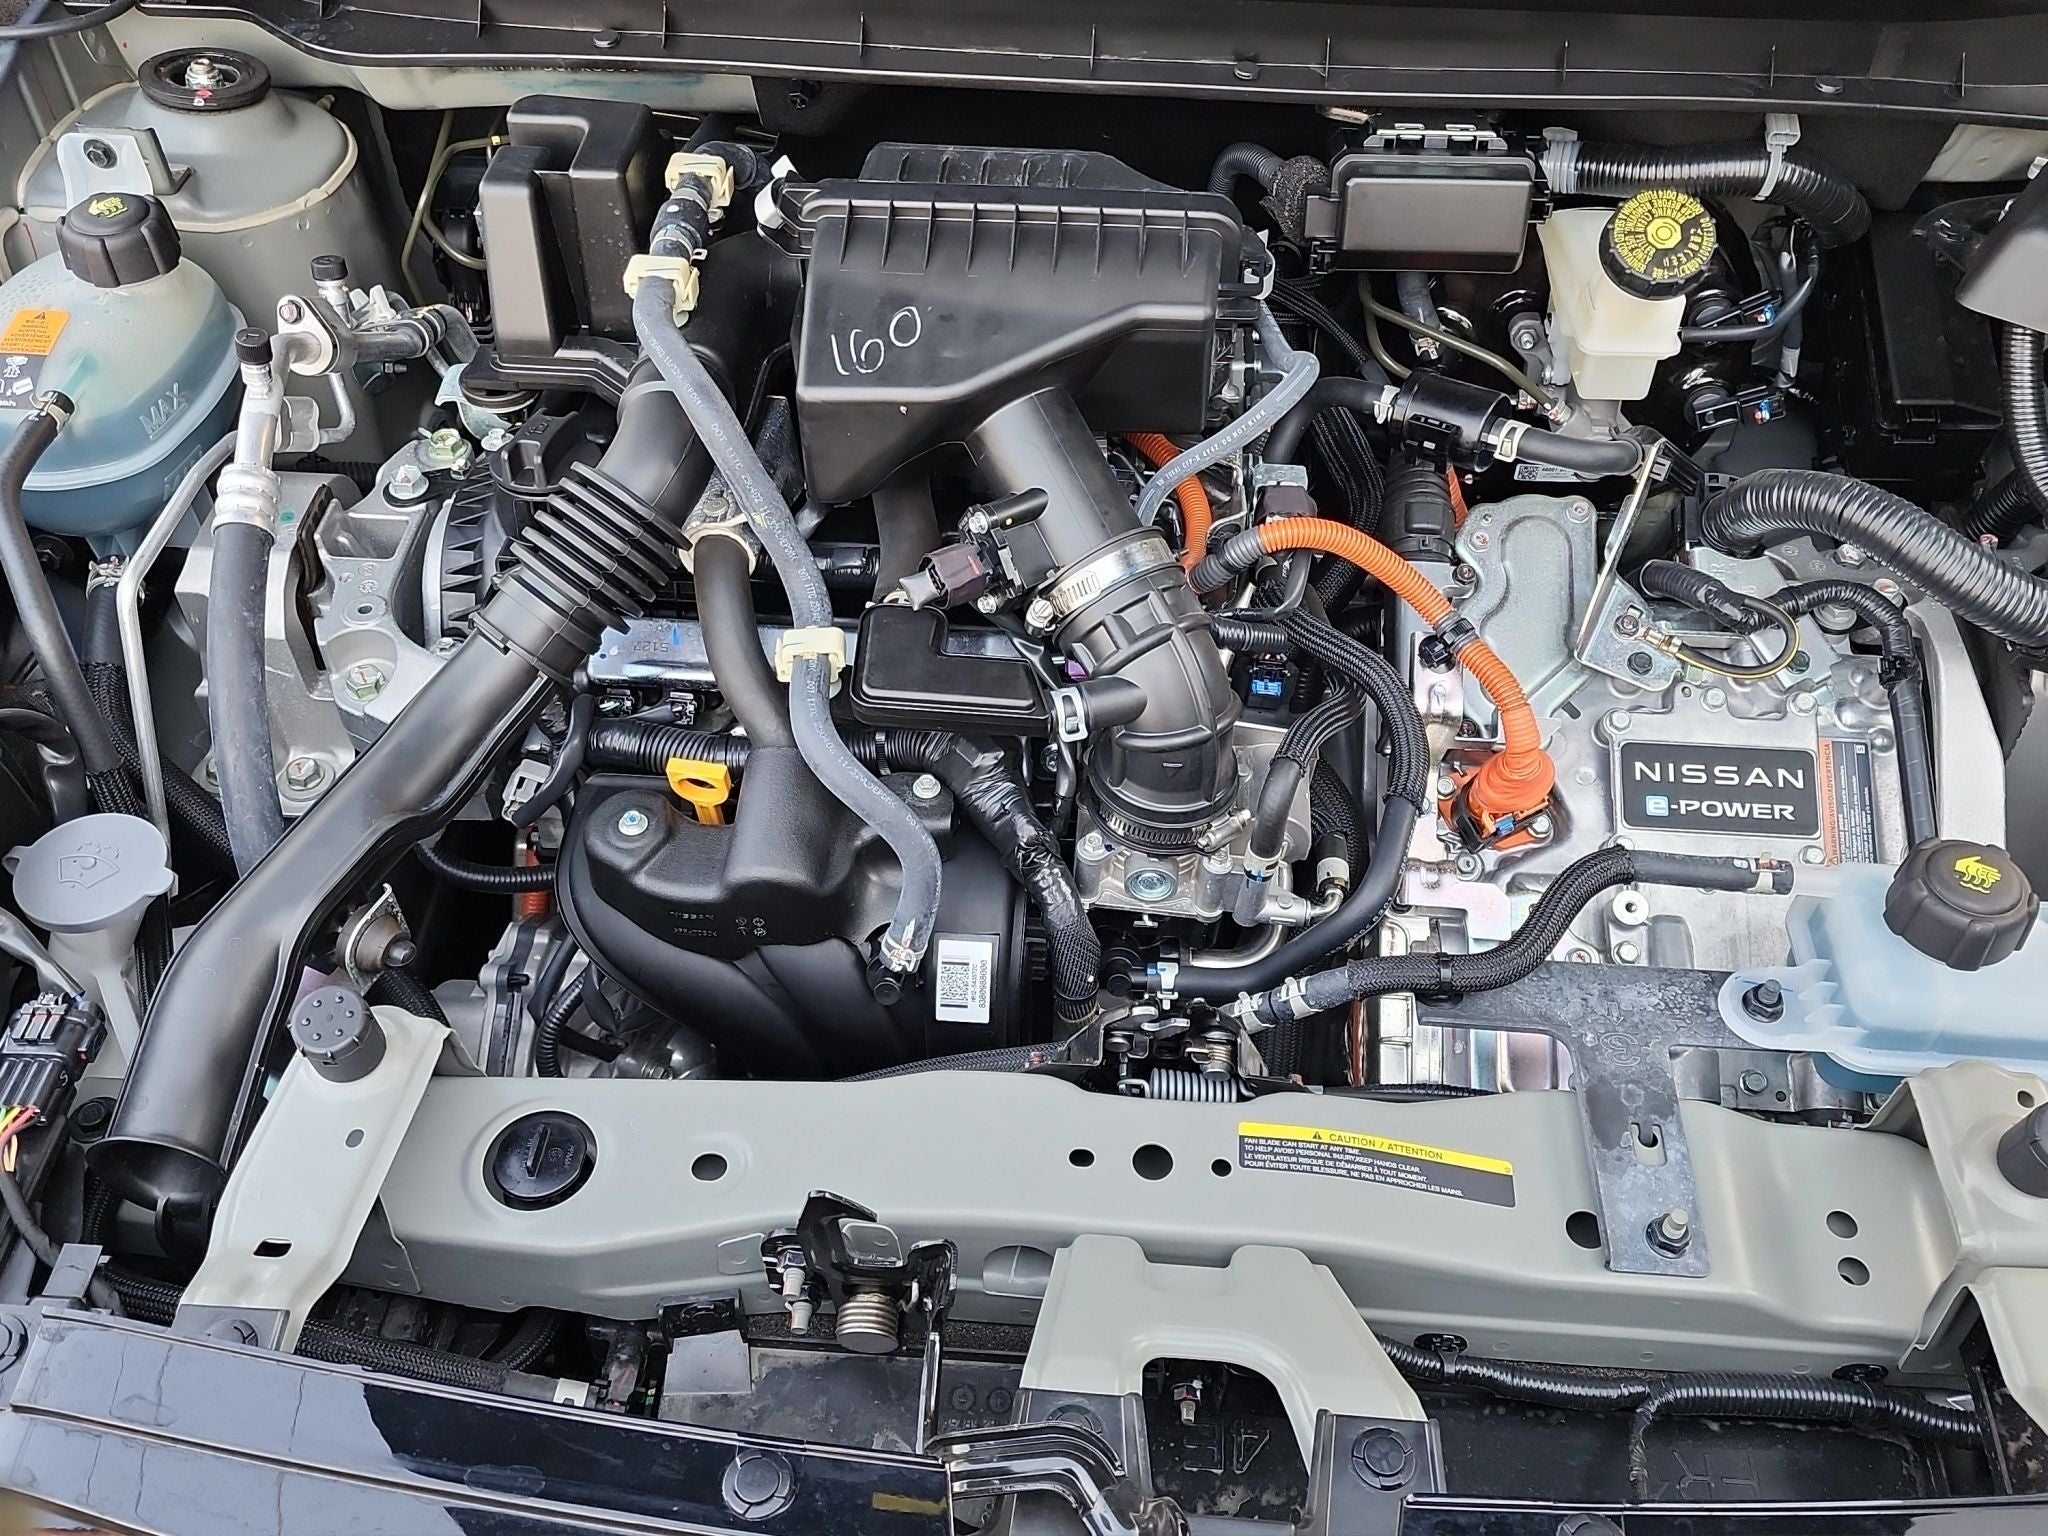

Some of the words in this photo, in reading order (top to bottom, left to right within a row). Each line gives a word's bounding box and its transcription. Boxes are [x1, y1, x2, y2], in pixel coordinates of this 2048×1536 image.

[1652, 199, 1682, 210] BEFORE
[1635, 213, 1652, 233] CLEAN
[1625, 236, 1636, 249] USE
[1633, 245, 1653, 264] ONLY
[1635, 234, 1656, 257] FILLER
[830, 306, 922, 376] 160
[139, 381, 187, 434] MAX
[711, 423, 728, 443] DOT
[1222, 436, 1232, 446] DO
[1232, 425, 1248, 438] NOT
[1247, 409, 1267, 426] KINK
[1634, 761, 1804, 789] NISSAN
[1282, 1140, 1297, 1148] CAN
[1298, 1142, 1319, 1150] START
[1329, 1133, 1376, 1148] CAUTION
[1387, 1143, 1443, 1160] ATTENTION
[1254, 1154, 1297, 1163] VENTILATEUR
[1298, 1157, 1324, 1166] RISQUE
[1379, 1168, 1396, 1177] TOUT
[1398, 1170, 1428, 1182] MOMENT.
[1255, 1145, 1273, 1153] HELP
[1274, 1147, 1295, 1155] AVOID
[1296, 1149, 1331, 1158] PERSONAL
[1374, 1159, 1397, 1169] HANDS
[1398, 1163, 1422, 1173] CLEAR.
[1265, 1161, 1288, 1170] ÉVITER
[1290, 1164, 1312, 1172] TOUTE
[1361, 1172, 1375, 1181] PAS
[1375, 1174, 1385, 1182] EN
[1386, 1175, 1427, 1190] APPROCHER
[1428, 1184, 1441, 1192] LES
